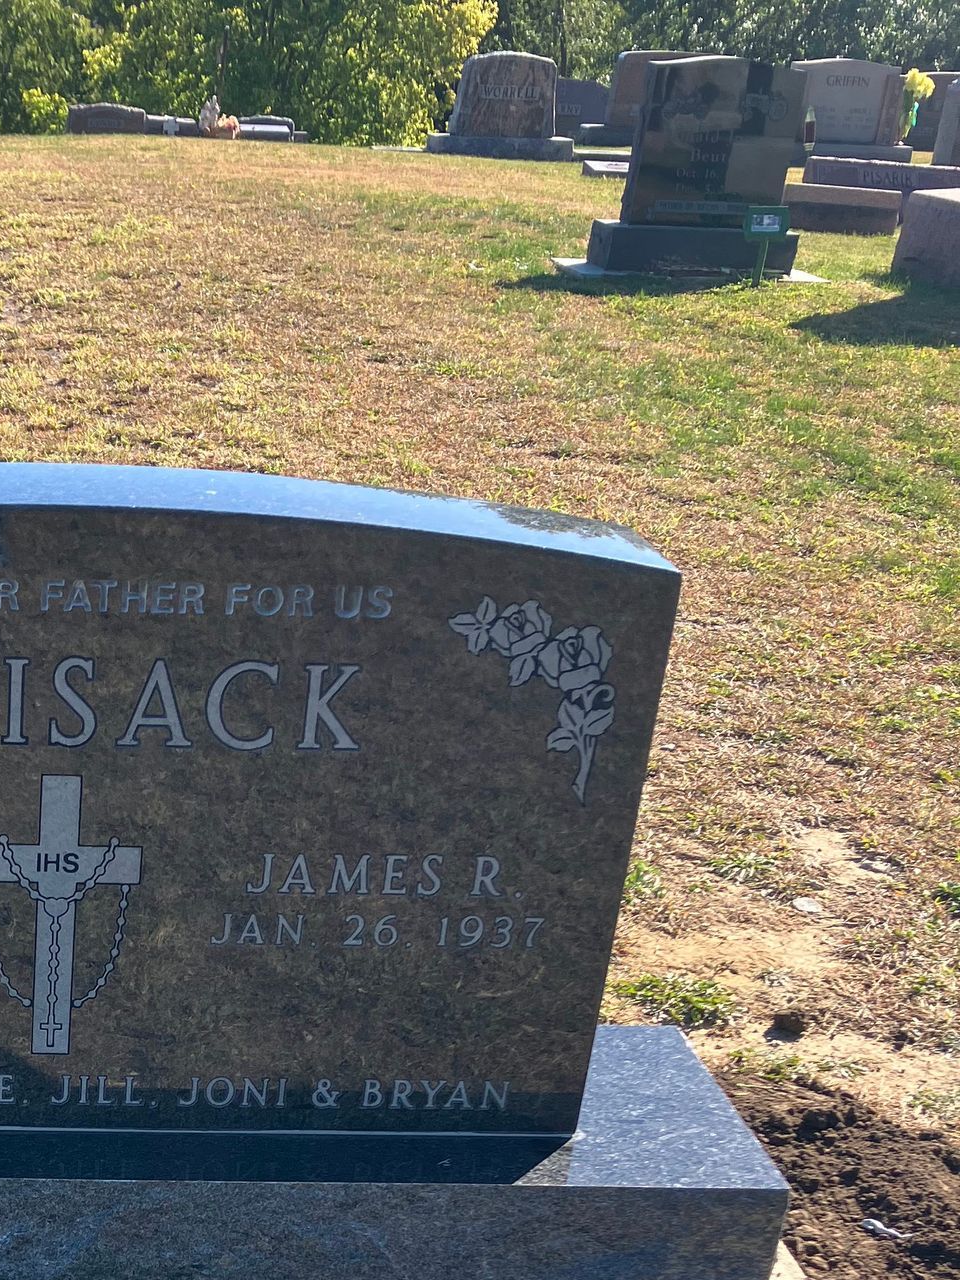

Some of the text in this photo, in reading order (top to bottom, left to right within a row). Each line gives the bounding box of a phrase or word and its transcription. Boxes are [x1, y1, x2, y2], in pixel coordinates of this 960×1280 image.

[826, 74, 870, 88] GRIFFIN
[41, 579, 205, 615] FATHER
[224, 583, 314, 617] FOR
[334, 586, 393, 619] US
[35, 853, 80, 874] IHS
[246, 853, 524, 899] JAMES R.
[210, 913, 317, 949] JAN.
[438, 916, 546, 949] 1937
[178, 1076, 287, 1108] JONI
[312, 1078, 340, 1108] &
[361, 1079, 511, 1110] BRYAN
